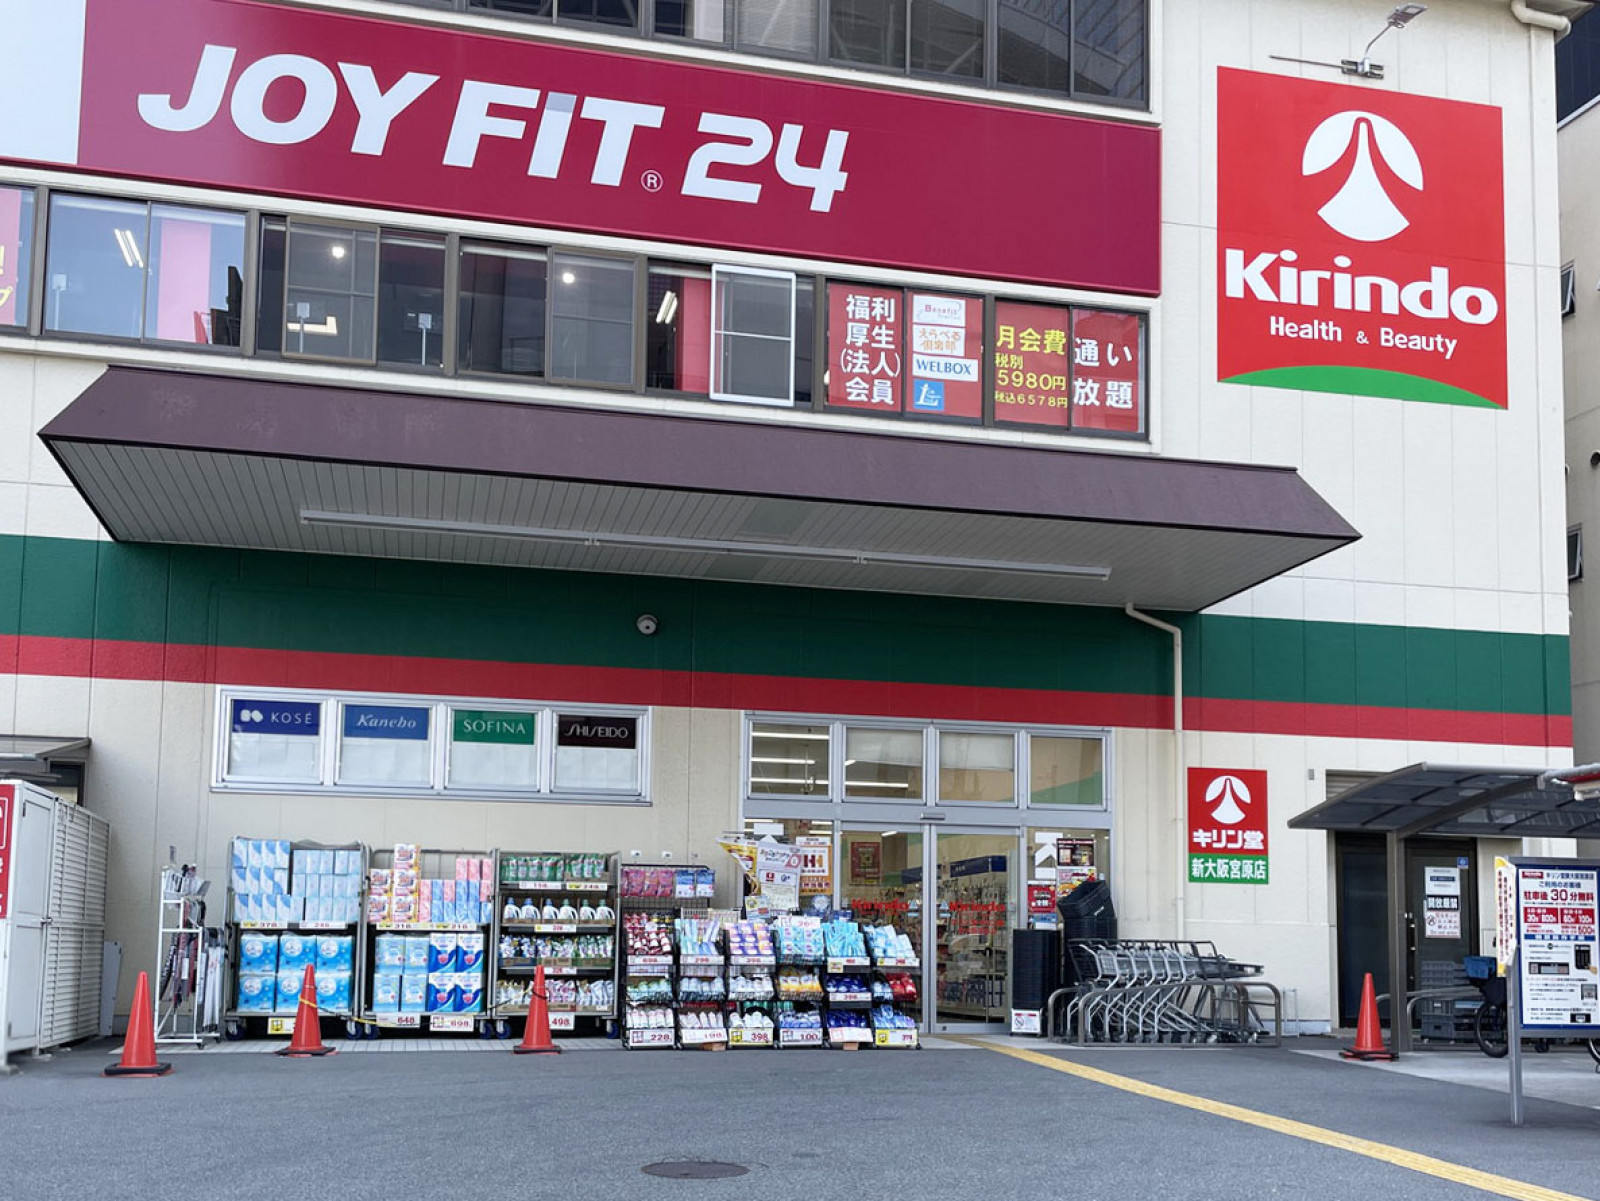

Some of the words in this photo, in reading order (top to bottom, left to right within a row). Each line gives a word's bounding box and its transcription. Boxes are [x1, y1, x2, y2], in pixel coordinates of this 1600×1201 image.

[137, 44, 441, 156] JOY
[442, 79, 666, 187] FIT
[681, 111, 849, 213] 24
[1225, 247, 1498, 325] Kirindo
[846, 294, 895, 322] 福利
[846, 322, 895, 349] 厚生
[996, 325, 1067, 355] 月会費
[1270, 315, 1342, 342] Health
[1355, 330, 1369, 345] &
[1380, 328, 1458, 360] Beauty
[995, 352, 1024, 370] 税別
[1074, 337, 1133, 367] 通い
[916, 359, 972, 375] WELBOX
[846, 376, 894, 405] 会員
[997, 369, 1067, 391] 5980円
[1073, 378, 1133, 409] 放題
[271, 711, 313, 724] KOSÉ
[356, 714, 417, 729] Kanebo
[463, 719, 526, 734] SOFINA
[565, 723, 629, 738] SHISEIDO
[1193, 828, 1265, 850] キリン堂
[1191, 858, 1267, 879] 新大阪宮原店
